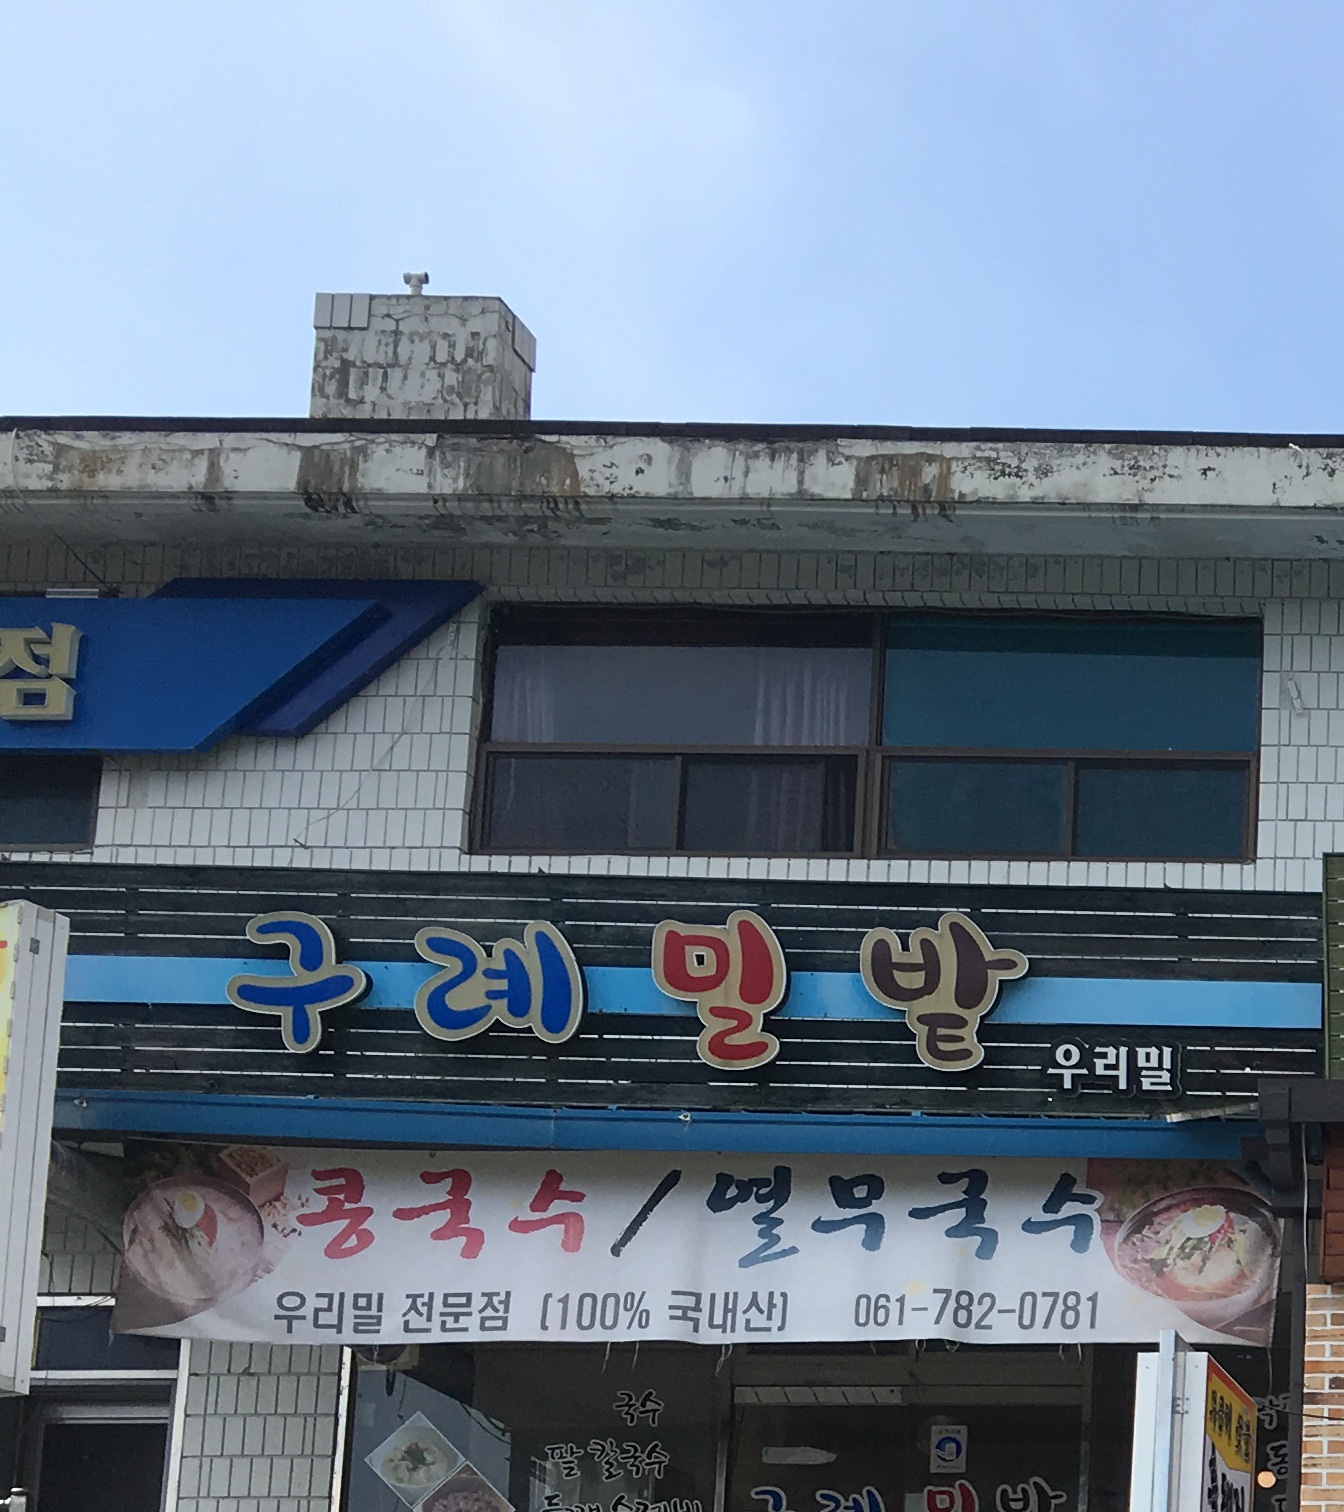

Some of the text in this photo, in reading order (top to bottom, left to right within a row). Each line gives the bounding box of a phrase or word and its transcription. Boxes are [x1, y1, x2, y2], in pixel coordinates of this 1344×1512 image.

[1045, 1042, 1174, 1093] 우리밀
[273, 1290, 385, 1335] 우리밀
[400, 1289, 512, 1335] 전문점
[854, 1289, 1100, 1331] 061-782-0781
[613, 1389, 665, 1427] 국수
[587, 1438, 671, 1483] 칼국수
